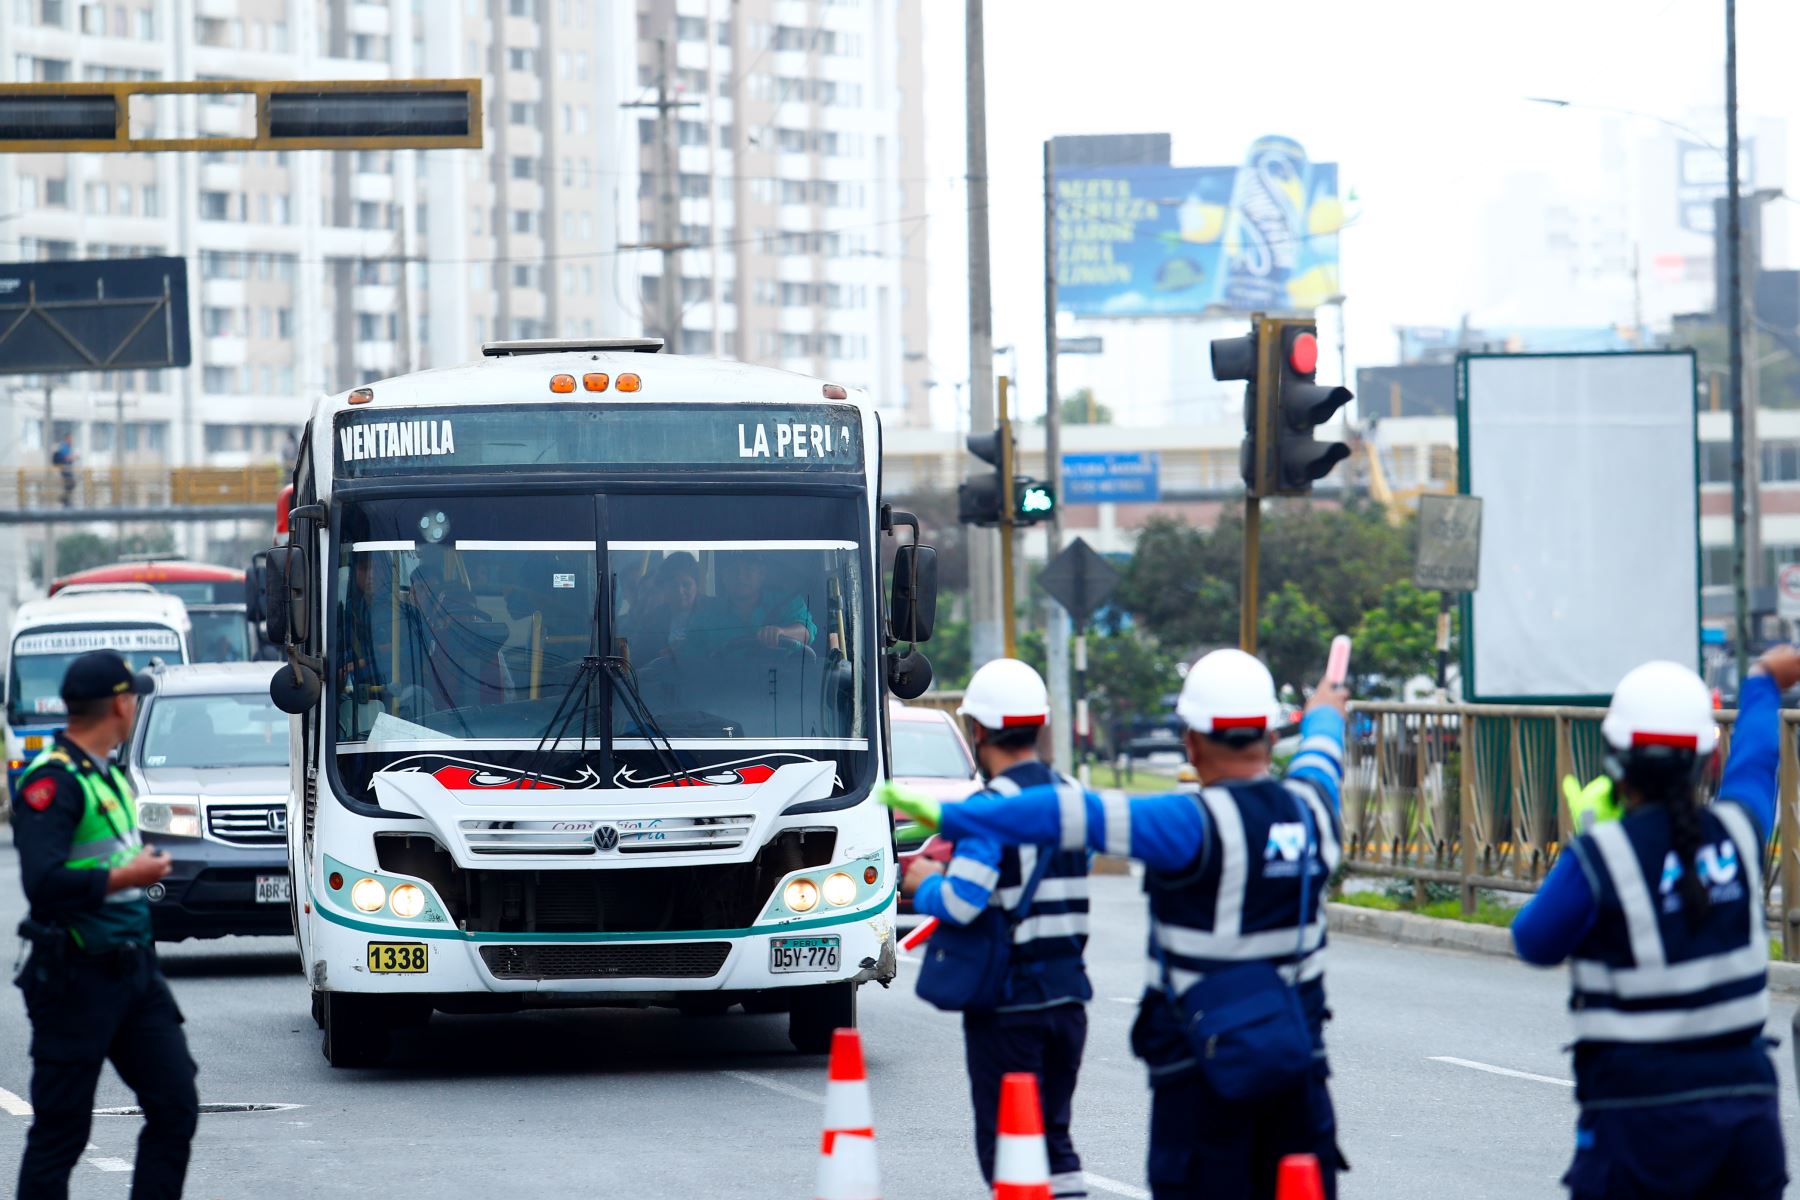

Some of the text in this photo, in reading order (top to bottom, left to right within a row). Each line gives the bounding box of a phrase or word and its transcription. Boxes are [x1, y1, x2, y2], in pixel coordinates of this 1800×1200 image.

[340, 420, 455, 462] VENTANILLA
[738, 423, 770, 458] LA
[370, 946, 425, 970] 1338
[774, 946, 836, 967] D5Y-776
